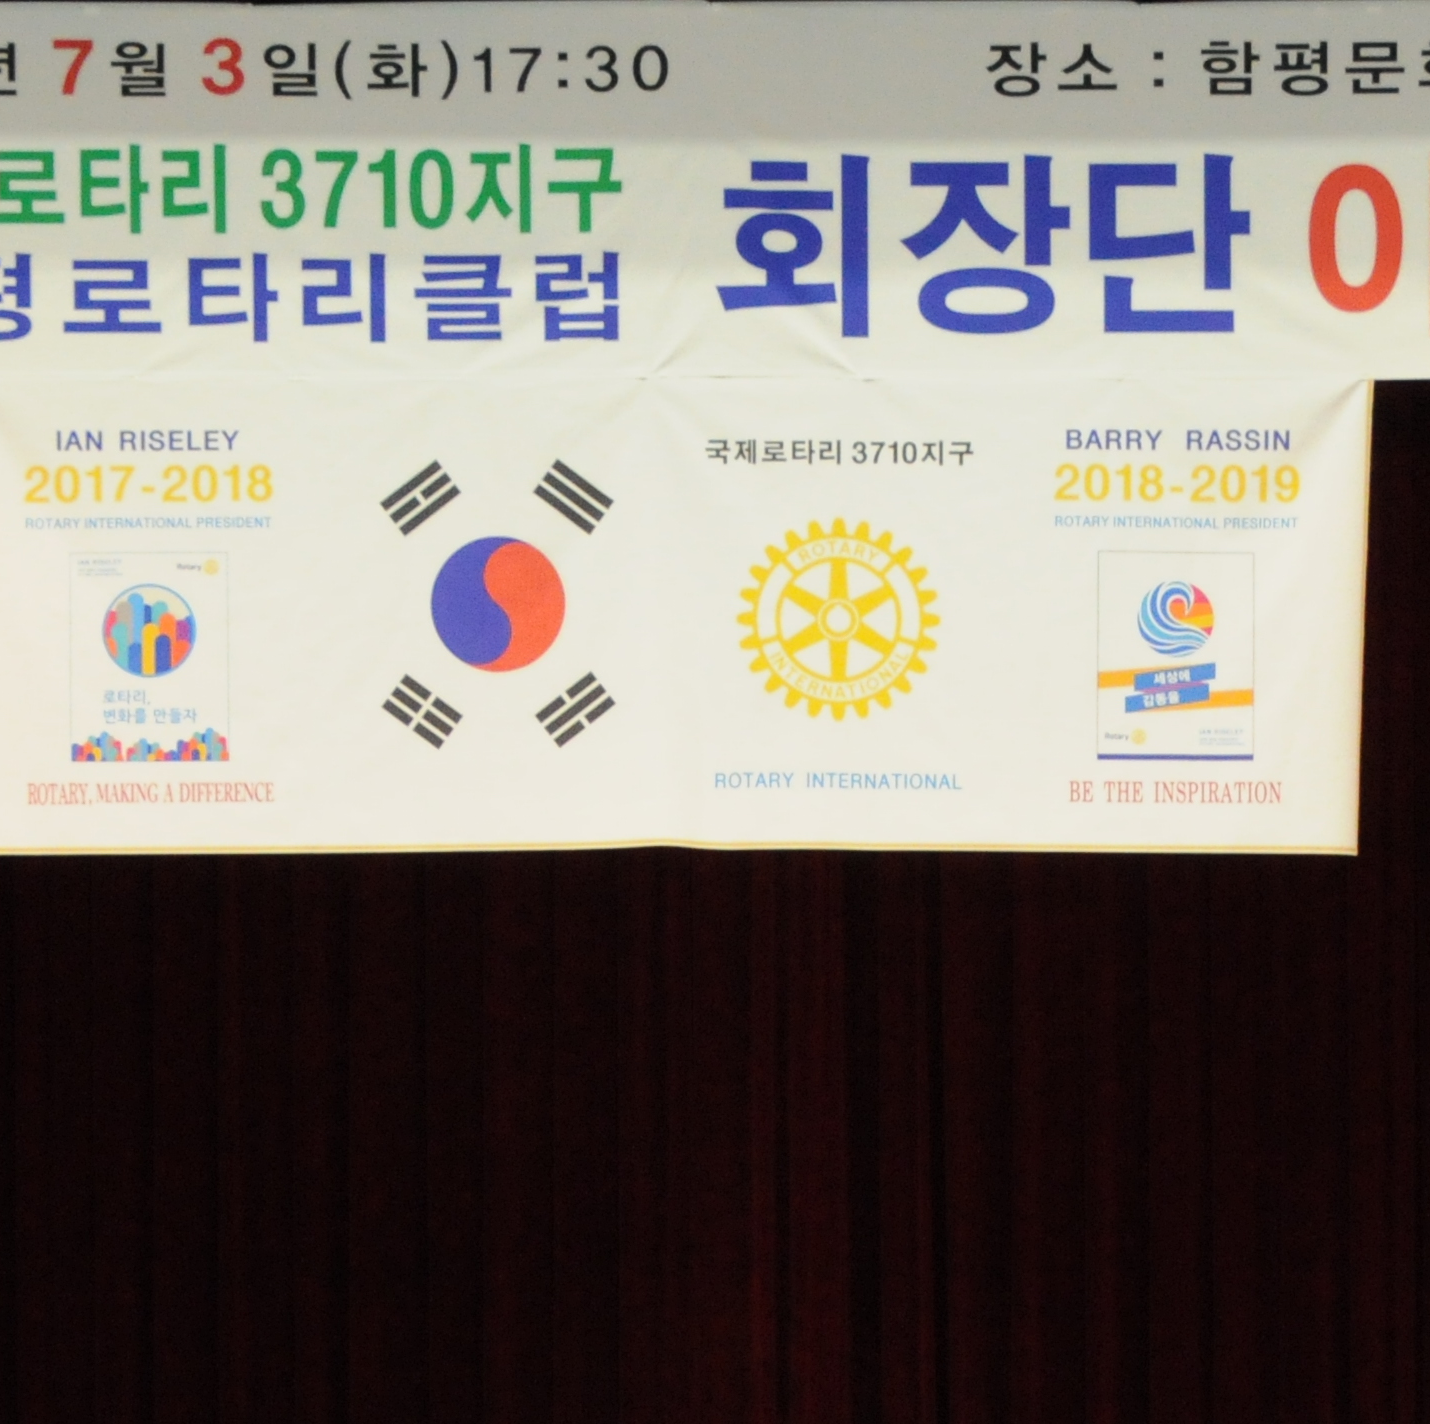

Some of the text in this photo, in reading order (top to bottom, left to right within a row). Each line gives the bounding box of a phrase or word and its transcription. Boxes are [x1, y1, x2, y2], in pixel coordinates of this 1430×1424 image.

[52, 38, 168, 98] 7월
[984, 40, 1119, 97] 장소
[716, 152, 1251, 338] 회장단
[55, 429, 240, 452] IAN RISELEY
[705, 439, 975, 467] 국제로타리 3710지구
[1065, 429, 1291, 452] BARRY RASSIN
[23, 464, 274, 503] 2017-2018
[1053, 463, 1301, 503] 2018-2019
[25, 516, 272, 529] ROTARY INTERNATIONAL PRESIDENT
[1054, 515, 1298, 530] ROTARY INTERNATIONAL PRESIDENT
[797, 538, 880, 565] ROTARY
[769, 648, 911, 700] INTERNATIONAL
[27, 781, 275, 806] ROTARY, MAKING A DIFFERENCE
[714, 772, 962, 790] ROTARY INTERNATIONAL
[1069, 781, 1283, 805] BE THE INSPIRATION
